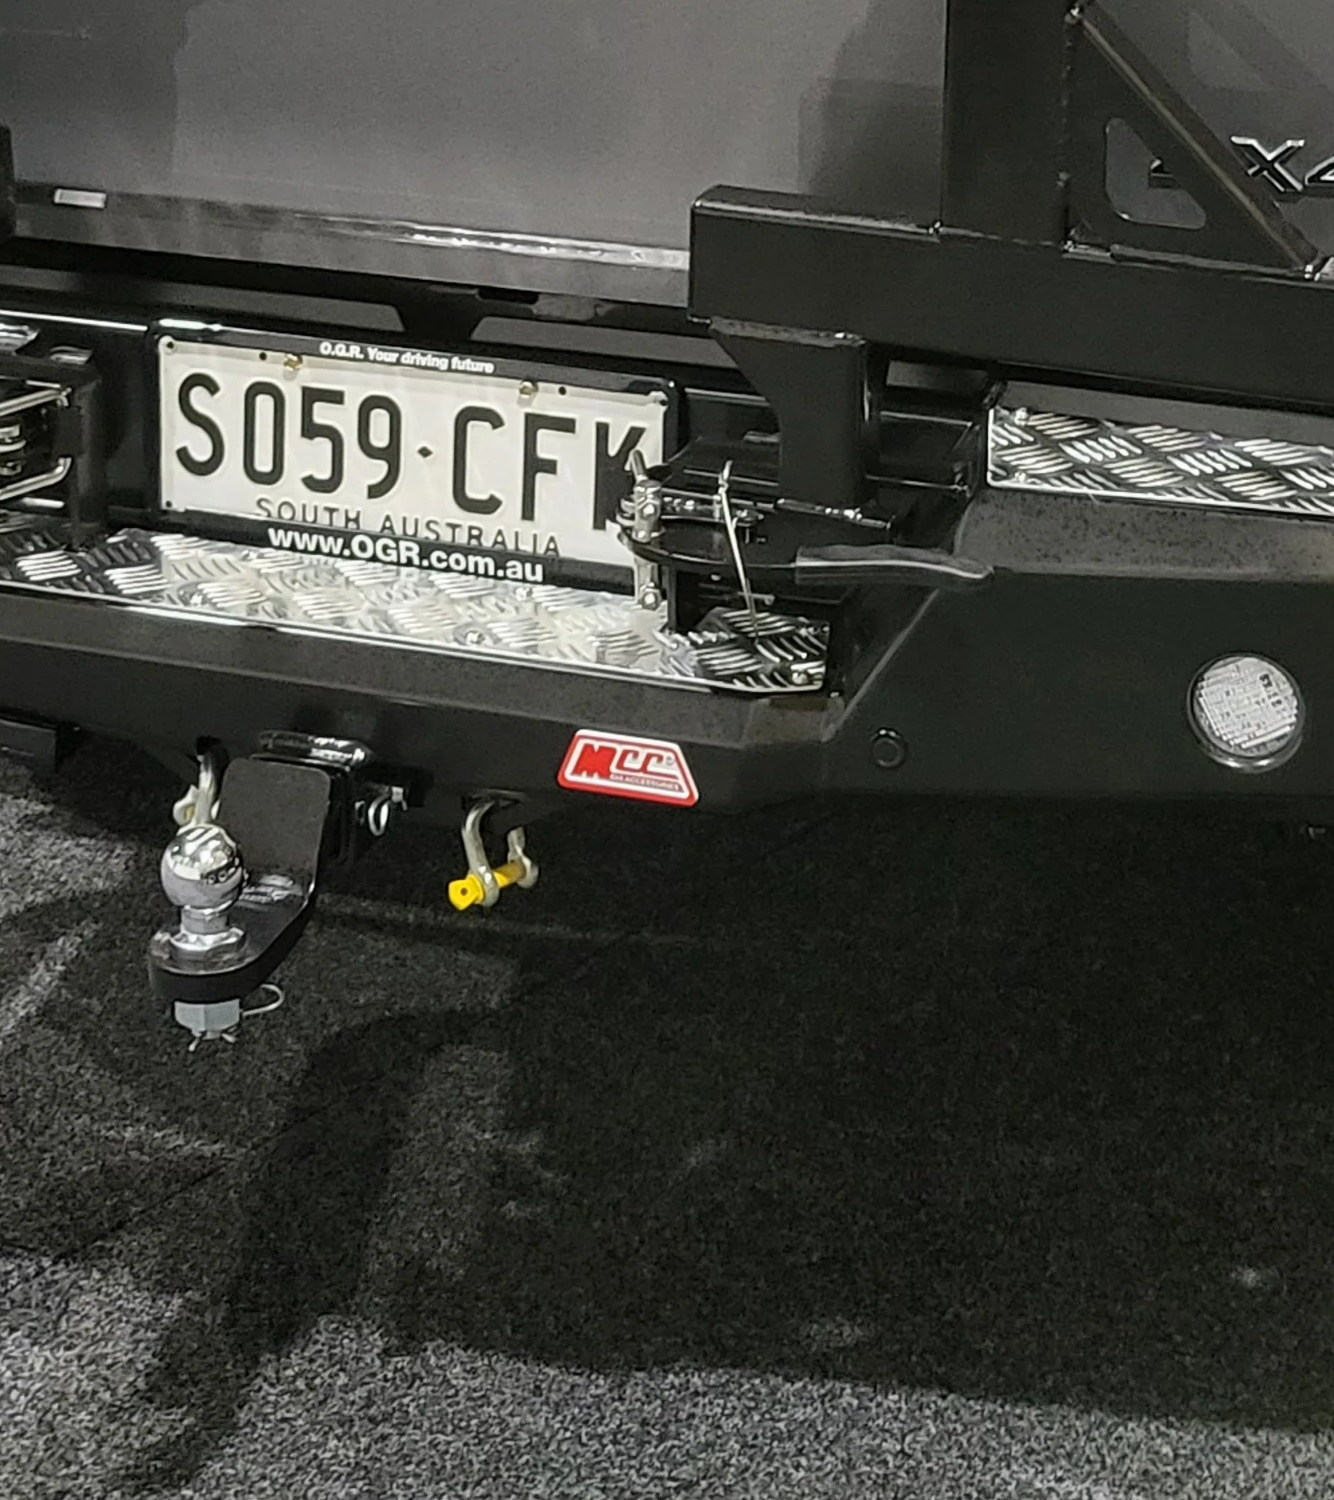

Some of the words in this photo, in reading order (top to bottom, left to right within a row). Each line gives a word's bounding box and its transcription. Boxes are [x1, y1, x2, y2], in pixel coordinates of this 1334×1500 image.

[367, 346, 400, 364] Your
[401, 351, 448, 370] driving
[450, 356, 495, 374] future
[255, 497, 361, 530] SOUTH
[379, 513, 561, 557] AUSTRALIA
[267, 526, 544, 583] www.OGR.com.au
